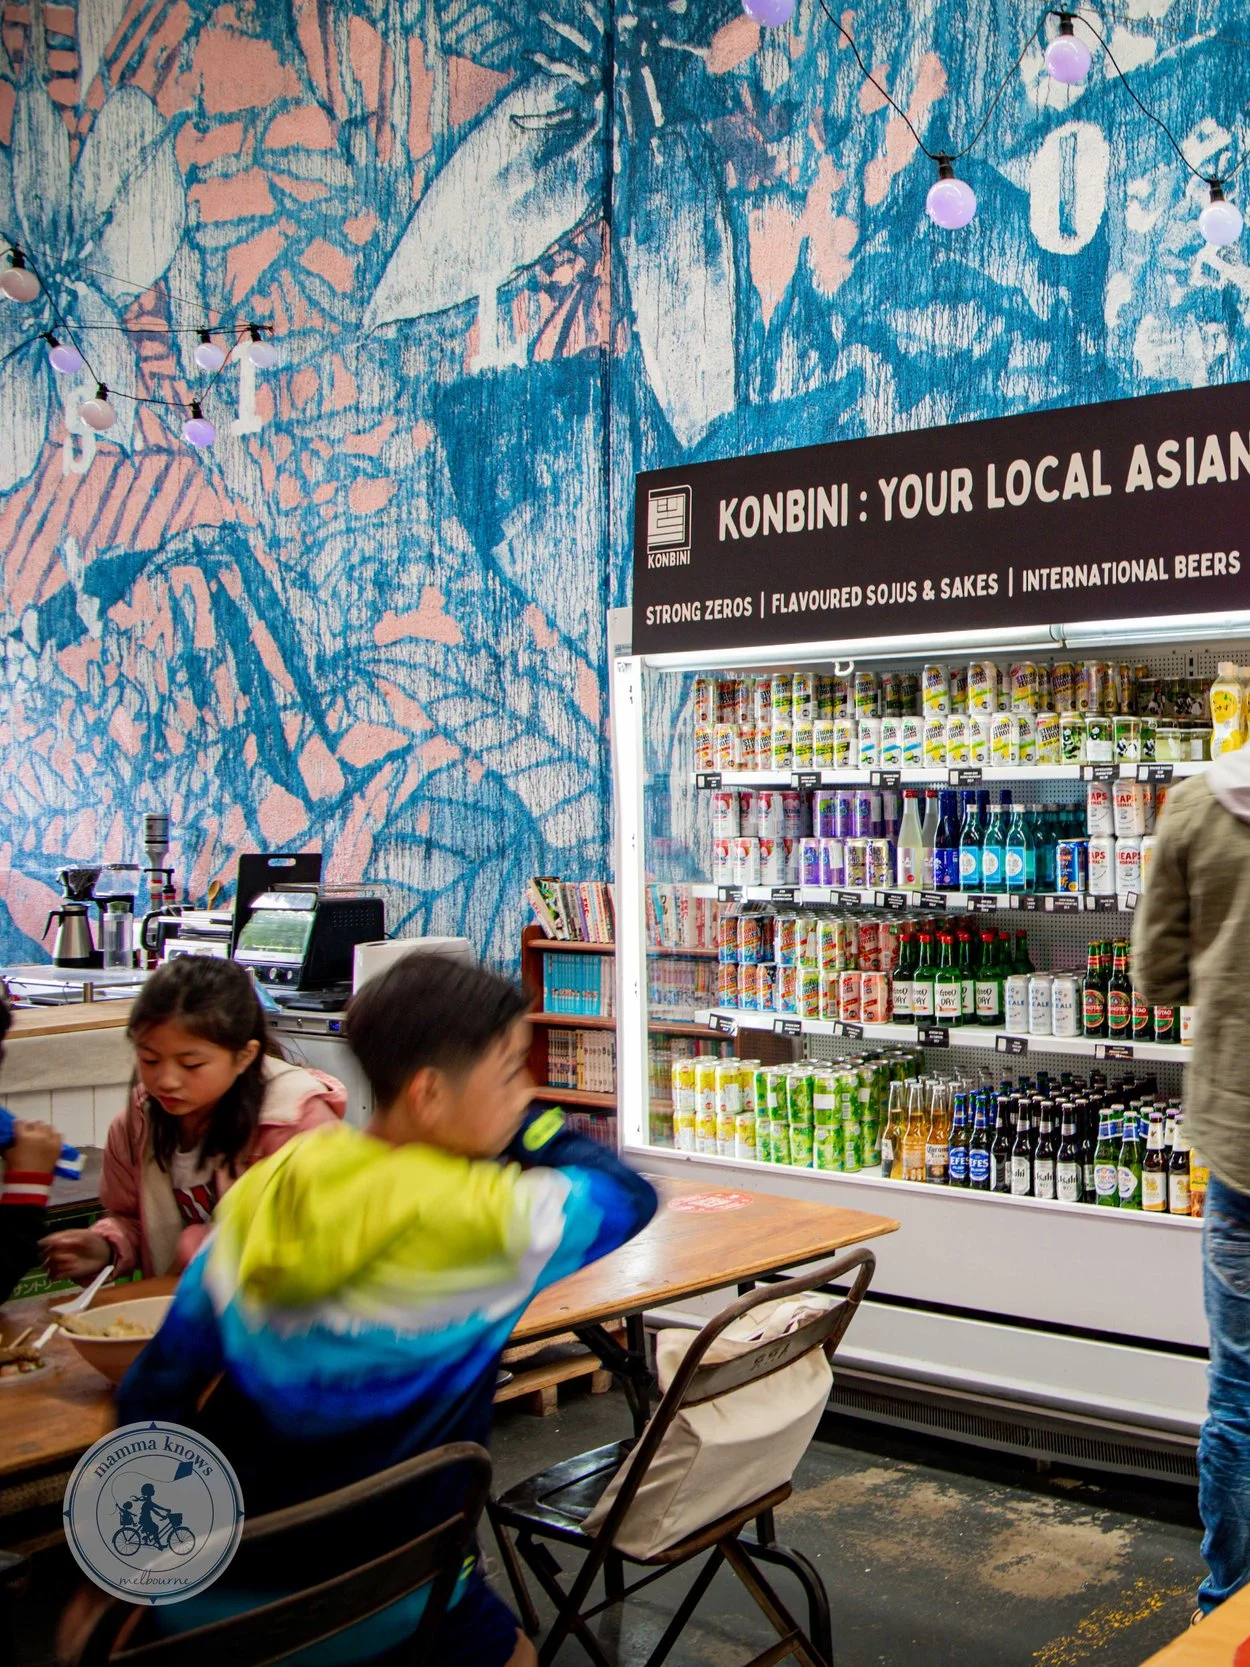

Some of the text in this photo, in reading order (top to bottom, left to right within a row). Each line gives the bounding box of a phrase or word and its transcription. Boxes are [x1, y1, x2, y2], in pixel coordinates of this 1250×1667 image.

[718, 482, 849, 542] KONBINI
[878, 467, 973, 522] YOUR
[987, 449, 1112, 509] LOCAL
[646, 600, 701, 626] STRONG
[704, 596, 752, 620] ZEROS
[772, 586, 862, 614] FLAVOURED
[866, 582, 917, 607] SOJUS
[922, 580, 935, 601] &
[941, 573, 999, 598] SAKES
[1022, 554, 1169, 593] INTERNATIONAL
[1174, 550, 1241, 579] BEERS
[647, 550, 691, 569] KONBINI
